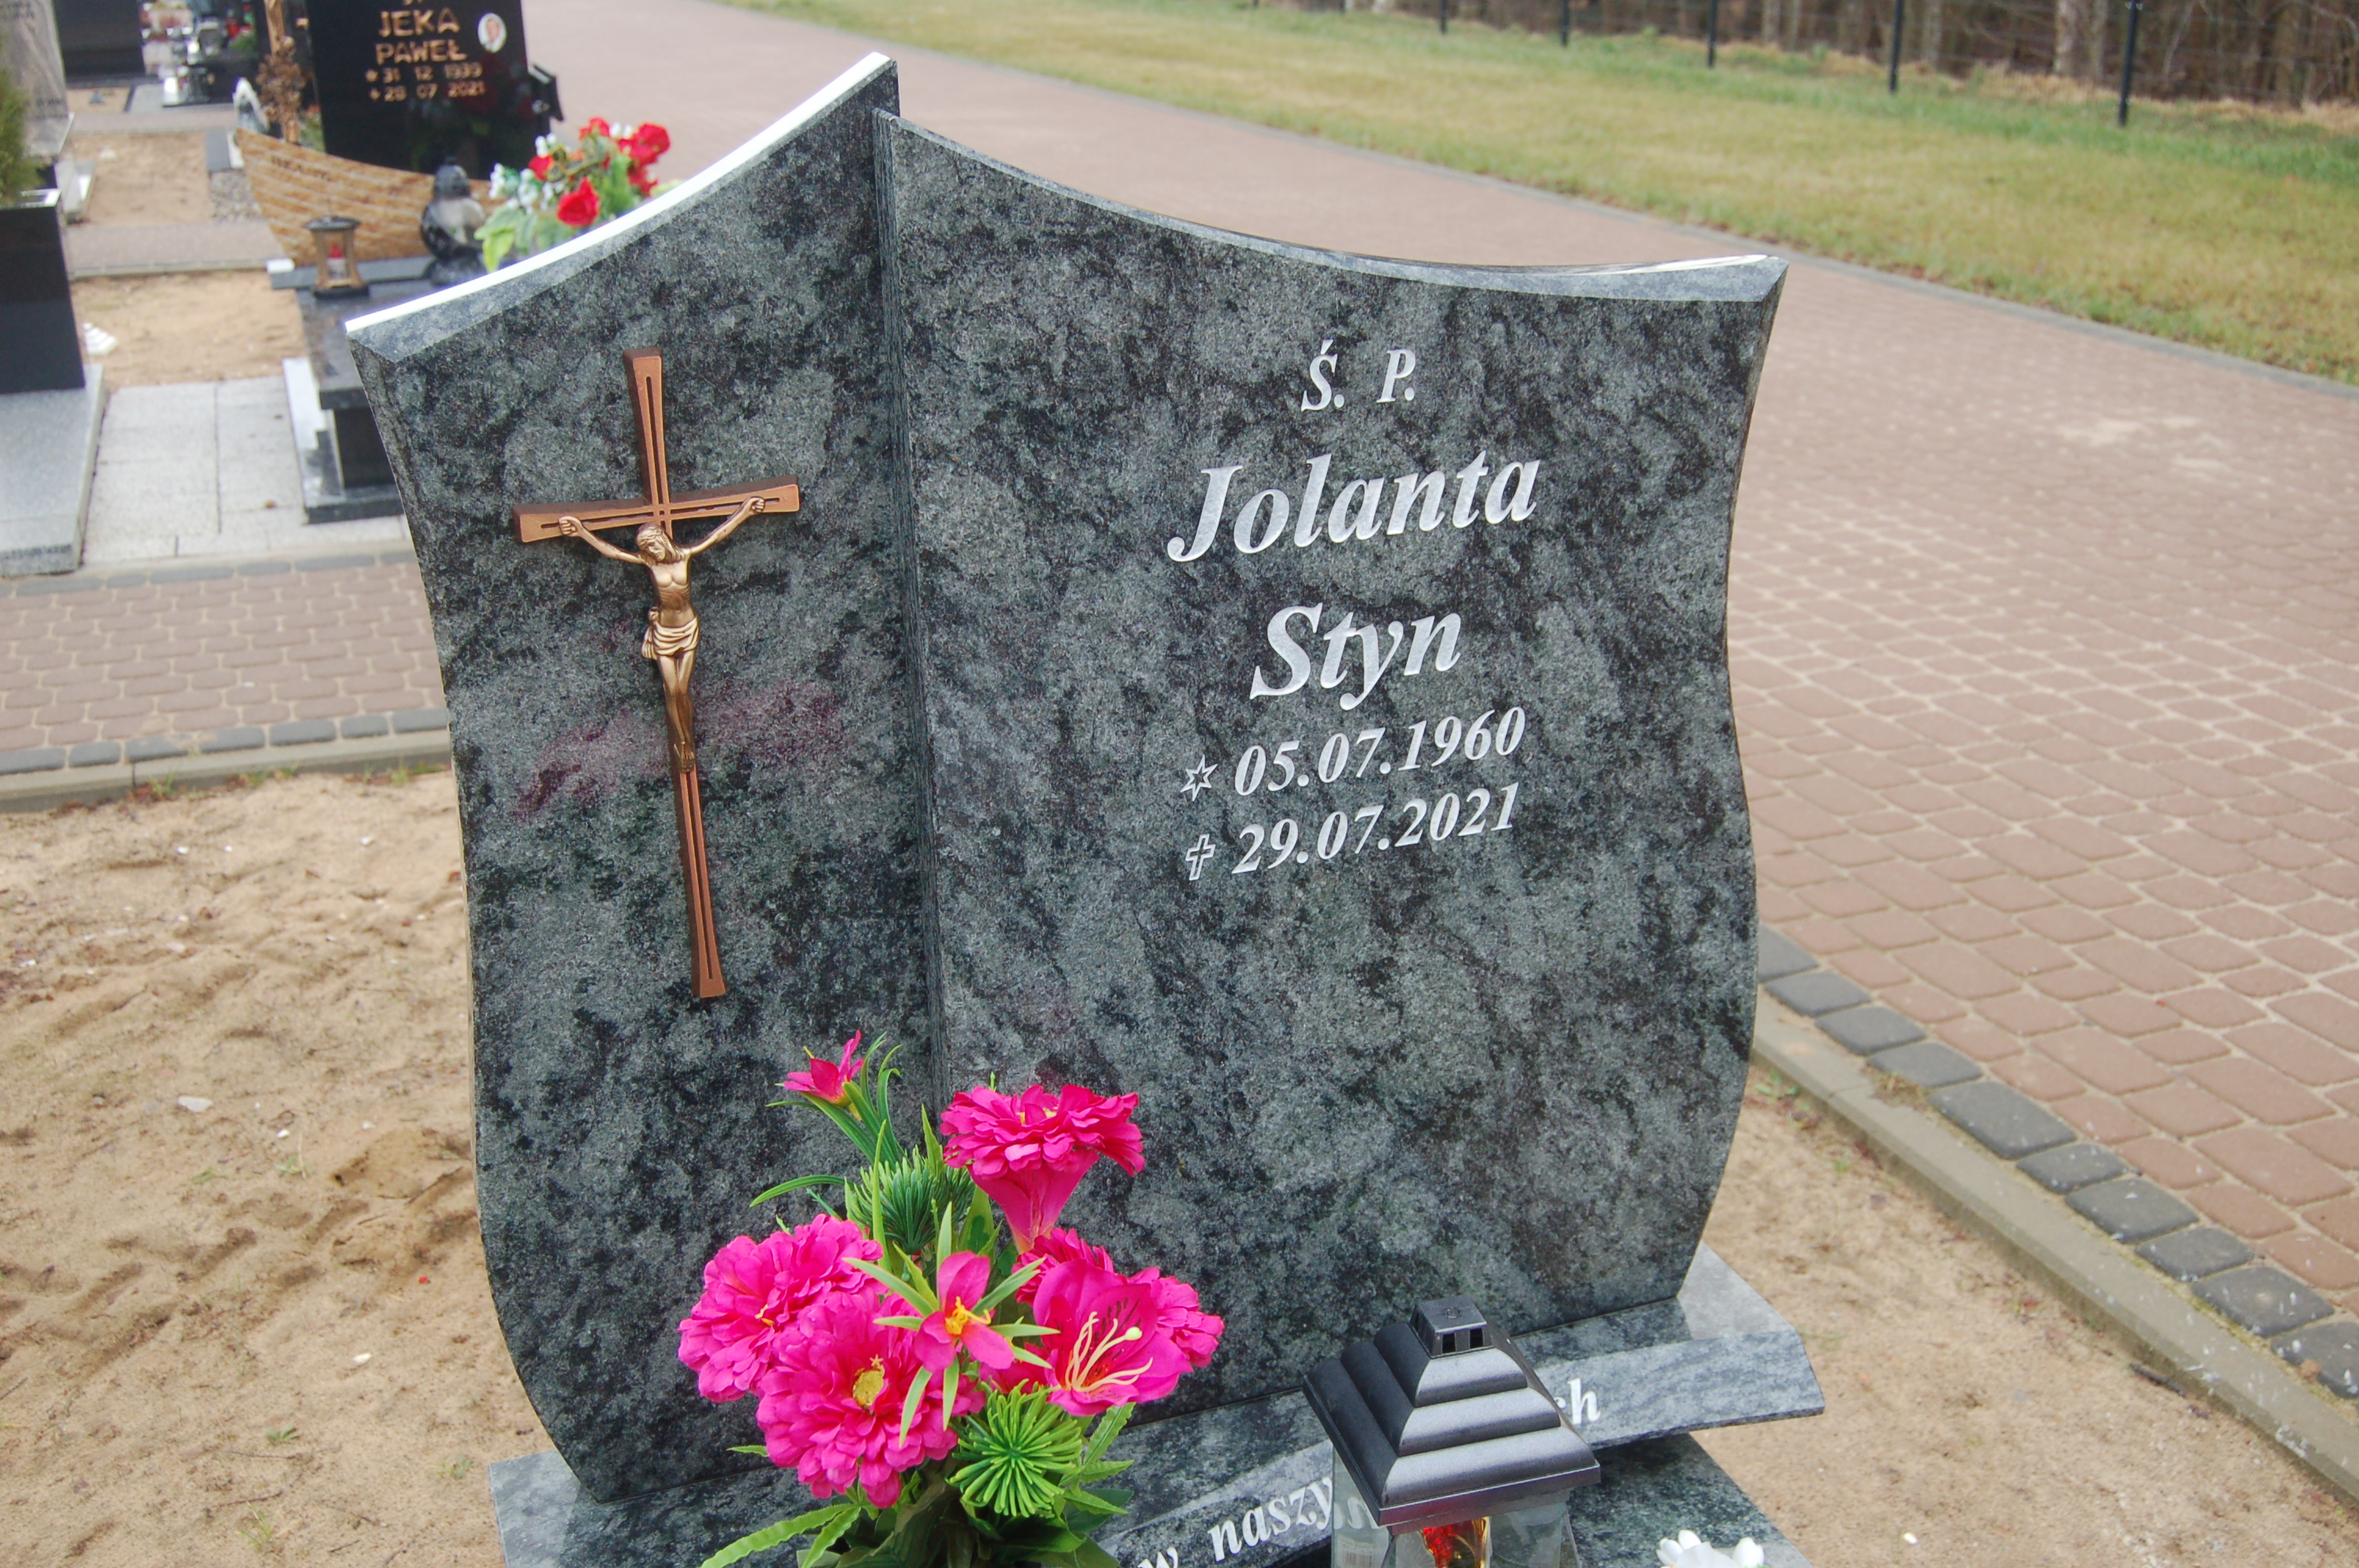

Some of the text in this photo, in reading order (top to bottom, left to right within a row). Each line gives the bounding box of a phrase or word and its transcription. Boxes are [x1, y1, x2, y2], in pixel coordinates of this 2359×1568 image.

[375, 39, 467, 65] PAWEŁ
[378, 8, 460, 37] JEKA
[1300, 339, 1416, 412] Ś. P.
[1166, 450, 1541, 562] Jolanta
[1249, 602, 1463, 711] Styn
[1234, 706, 1526, 796] 05.07.1960
[1231, 782, 1519, 874] 29.07.2021
[1207, 1476, 1332, 1562] naszy
